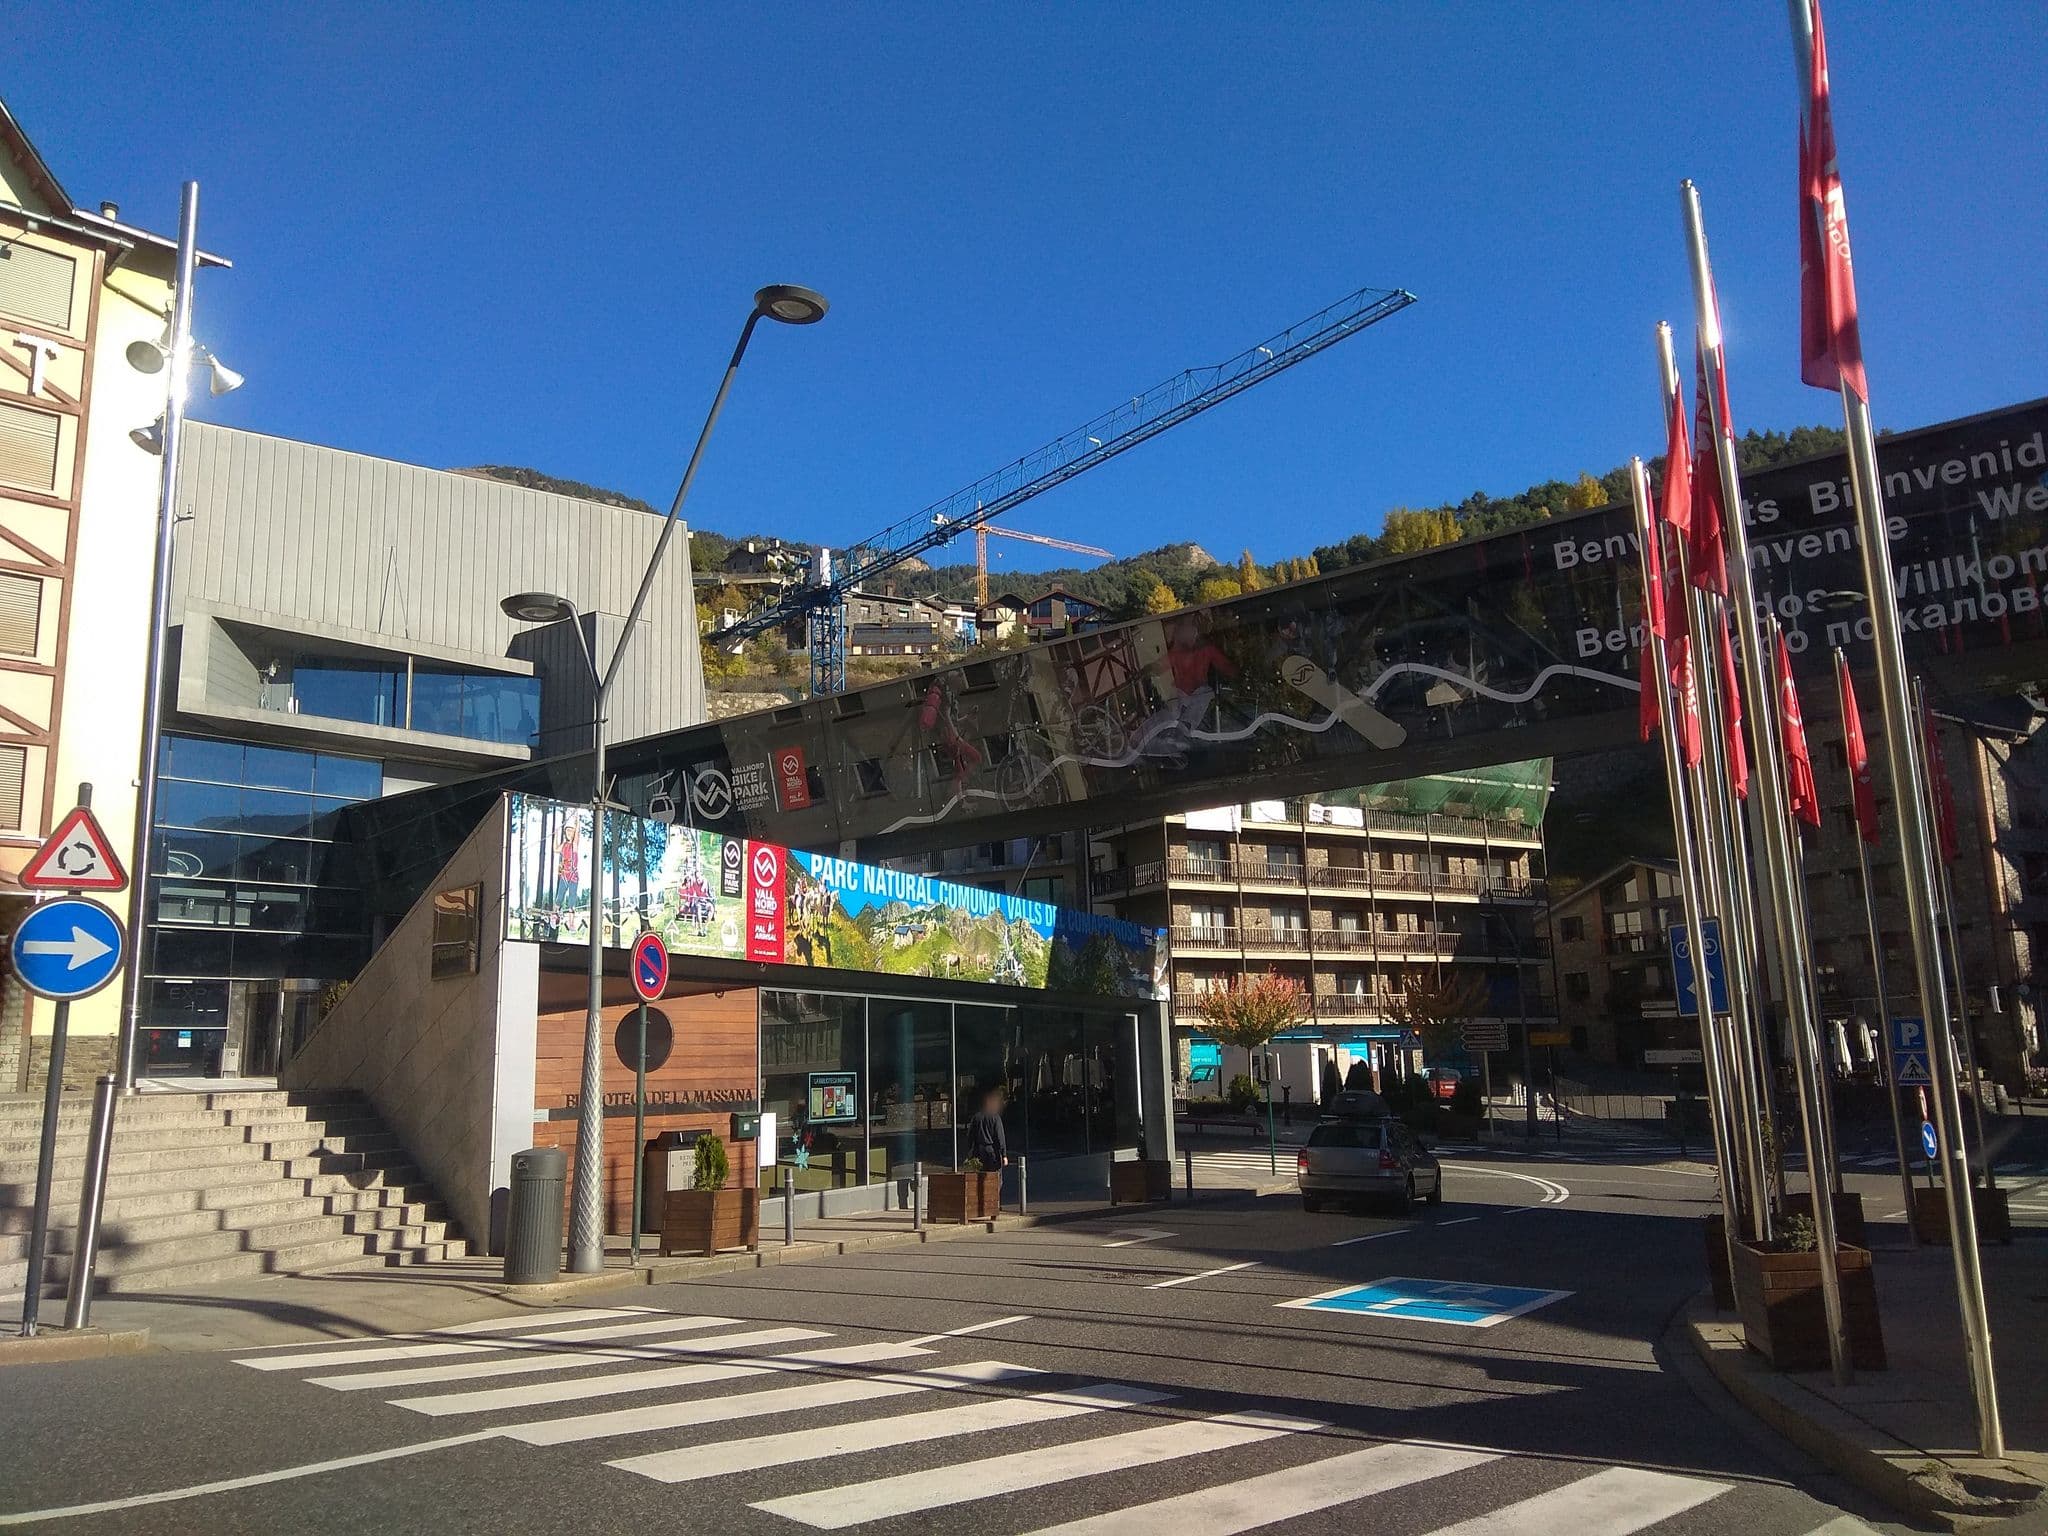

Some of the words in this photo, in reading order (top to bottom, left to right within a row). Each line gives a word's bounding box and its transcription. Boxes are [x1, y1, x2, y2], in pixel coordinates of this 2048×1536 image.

[14, 332, 64, 396] T
[1553, 498, 1780, 570] Benvts
[1808, 432, 2046, 515] Binvenid
[1826, 585, 2048, 647] поалов
[731, 762, 765, 775] VALLNORD
[732, 771, 758, 786] BIKE
[733, 781, 768, 799] PARK
[755, 888, 775, 900] VALL
[811, 855, 859, 891] PARC
[863, 864, 936, 905] NATURAL
[1007, 896, 1044, 926] VALLS
[755, 898, 777, 910] NORD
[565, 1092, 650, 1108] BIOTEC
[652, 1090, 670, 1104] DE
[673, 1089, 689, 1104] LA
[694, 1088, 752, 1104] MASSANA
